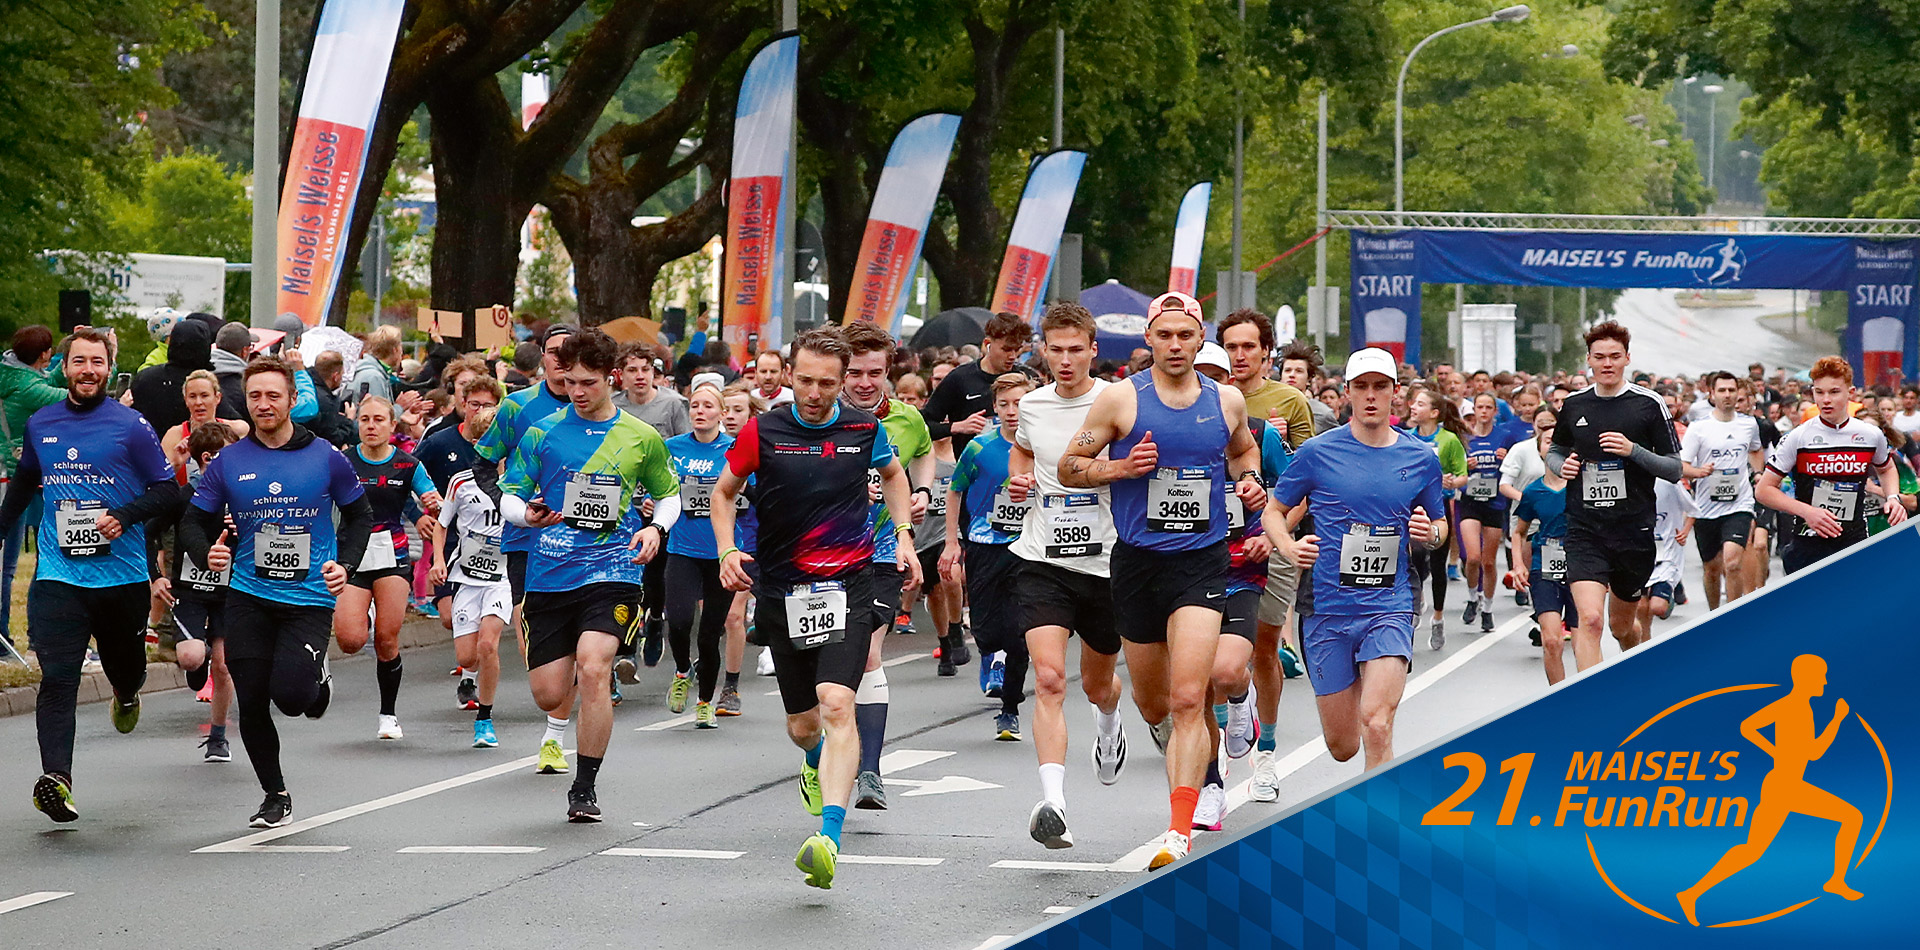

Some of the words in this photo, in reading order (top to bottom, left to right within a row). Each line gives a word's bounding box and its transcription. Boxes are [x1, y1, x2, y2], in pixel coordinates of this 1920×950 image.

[297, 132, 339, 206] Weisse
[322, 171, 350, 261] ALKOHOLFREI
[738, 184, 762, 240] Weisse
[282, 214, 323, 295] Maisel's
[867, 229, 897, 276] Weisse
[1522, 249, 1626, 267] MAISEL'S
[1632, 250, 1714, 268] FunRun
[1359, 276, 1414, 296] START
[1856, 285, 1913, 305] START
[854, 280, 882, 322] aisel's
[1712, 449, 1741, 458] BAT
[1818, 454, 1856, 462] TEAM
[53, 462, 92, 470] schlaeger
[1806, 462, 1867, 473] ICEHOUSE
[44, 475, 82, 485] UNNING
[84, 475, 115, 485] TEAM
[238, 473, 256, 481] JAKO
[1168, 488, 1194, 497] Koltsov
[1590, 486, 1618, 499] 3170
[1715, 485, 1735, 494] 3905
[253, 496, 298, 506] schlaeger
[579, 491, 606, 500] Susanne
[690, 497, 710, 508] 343
[287, 508, 319, 518] TEAM
[573, 502, 609, 519] 3069
[1159, 501, 1200, 518] 3496
[577, 521, 603, 529] cep
[1164, 522, 1193, 531] cep
[65, 529, 100, 545] 3485
[1054, 526, 1090, 543] 3589
[70, 547, 96, 555] cep
[1059, 546, 1086, 555] cep
[1364, 544, 1381, 552] Leon
[264, 552, 300, 568] 3486
[468, 555, 498, 571] 3805
[1351, 556, 1389, 573] 3147
[268, 571, 294, 579] cep
[470, 570, 492, 580] cep
[1356, 577, 1382, 585] cep
[192, 584, 215, 592] cep
[807, 601, 827, 611] Jacob
[799, 613, 834, 634] 3148
[806, 633, 829, 645] cep
